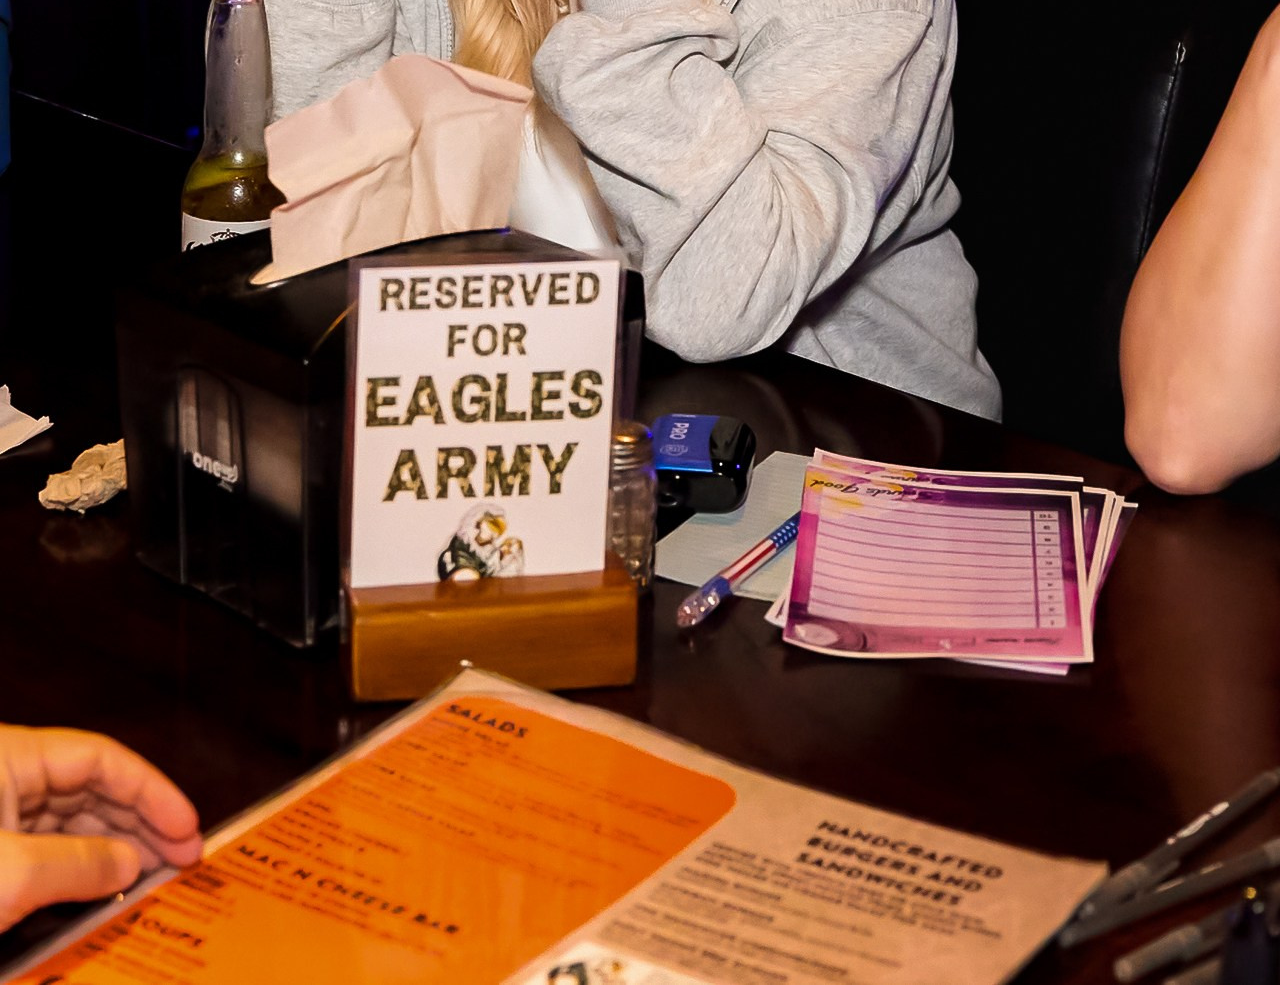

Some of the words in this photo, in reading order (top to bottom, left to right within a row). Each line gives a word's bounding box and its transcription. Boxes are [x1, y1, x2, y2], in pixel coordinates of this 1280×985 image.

[380, 271, 601, 312] RESERVED
[447, 323, 527, 357] FOR
[365, 369, 603, 427] EAGLES
[669, 422, 690, 440] PRO
[382, 442, 579, 502] ARMY
[447, 704, 528, 738] SALADS
[235, 845, 289, 870] MAC
[807, 837, 919, 875] BURGERS
[926, 871, 982, 892] AND
[817, 820, 1003, 878] HANDCRAFTED
[797, 852, 961, 905] SANDWICHES
